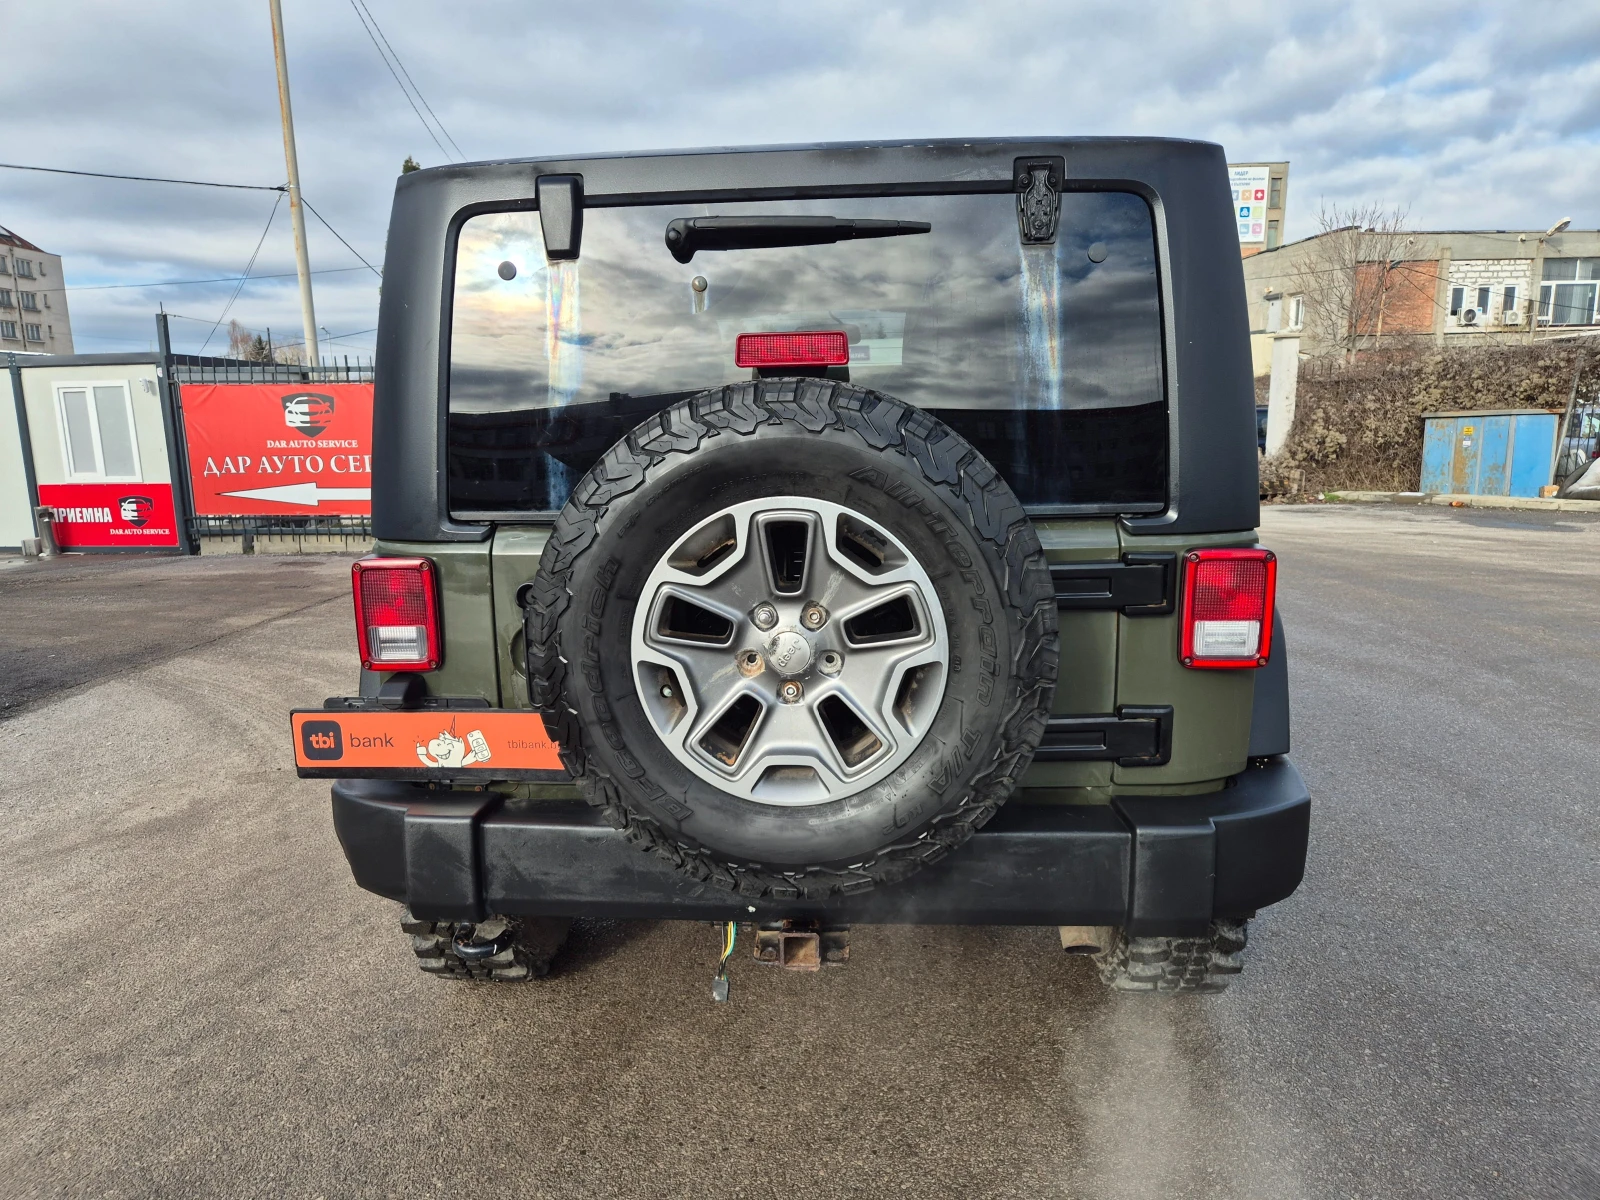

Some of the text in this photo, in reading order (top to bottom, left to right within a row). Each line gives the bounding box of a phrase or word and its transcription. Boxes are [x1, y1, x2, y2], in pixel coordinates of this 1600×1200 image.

[267, 439, 358, 449] DAR AUTO SERVICE
[203, 455, 251, 478] ДАР
[257, 454, 324, 474] АУТО
[777, 638, 802, 668] Jeep
[580, 556, 694, 821] BFGoodrich
[309, 731, 395, 749] tbi bank
[507, 739, 557, 750] tbibank.b
